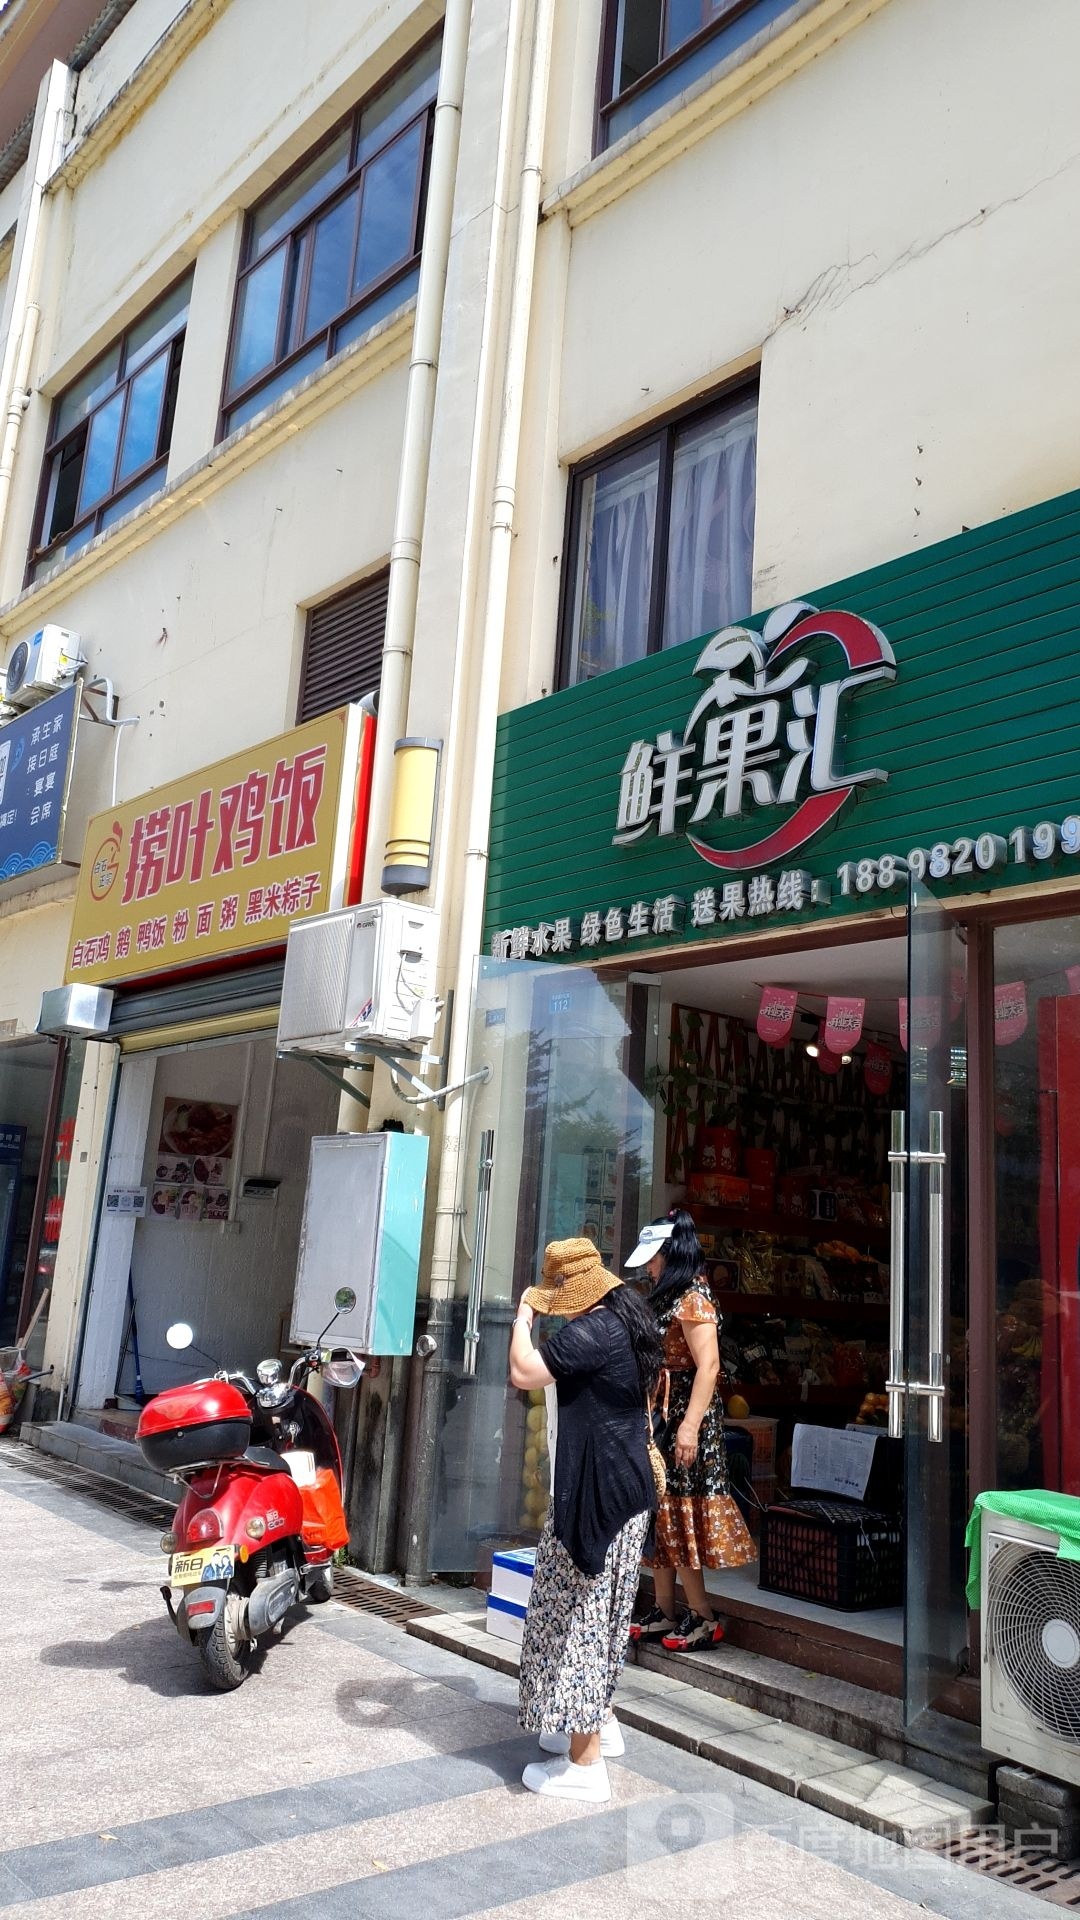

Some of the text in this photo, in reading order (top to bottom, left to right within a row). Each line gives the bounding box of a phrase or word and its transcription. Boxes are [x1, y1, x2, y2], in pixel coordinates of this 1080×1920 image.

[612, 665, 896, 846] 鲜果汇
[121, 744, 328, 905] 捞叶鸡饭
[71, 872, 321, 969] 白石鸡 鹅 鸭饭 粉 面 粥 黑米粽子
[491, 916, 572, 962] 新鲜水果
[580, 895, 675, 947] 绿色生活
[174, 1557, 204, 1574] 新日
